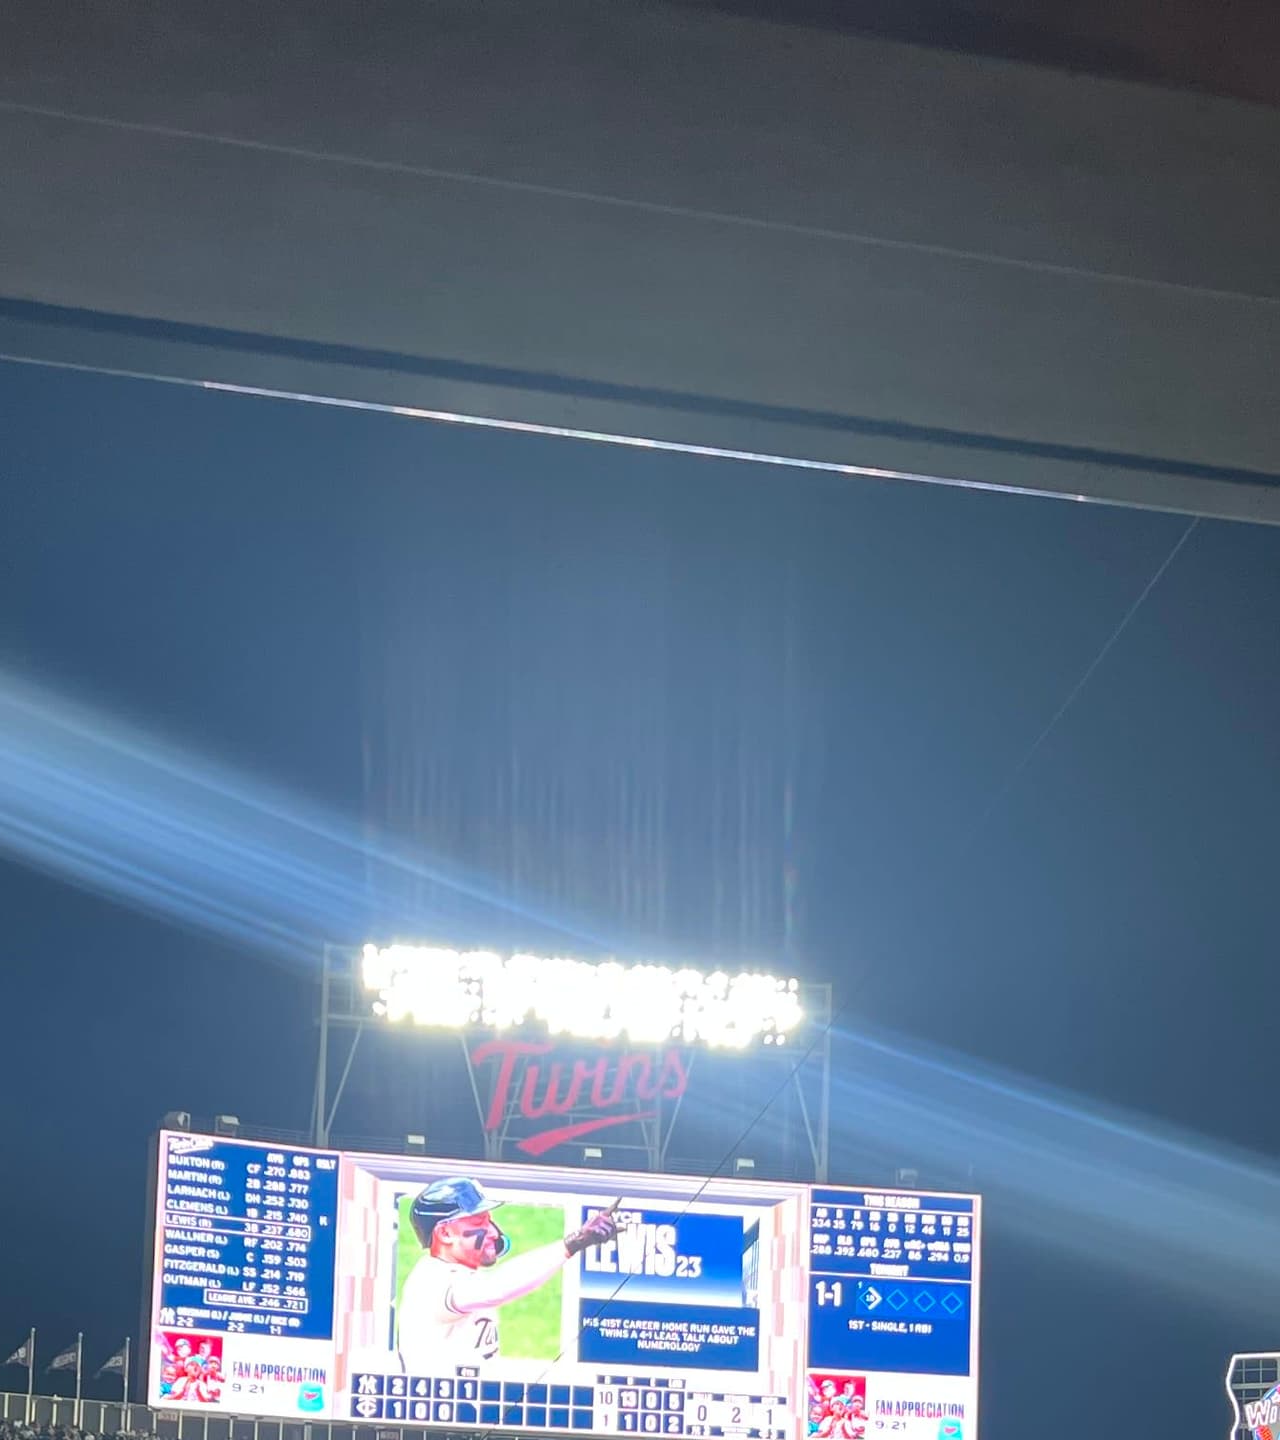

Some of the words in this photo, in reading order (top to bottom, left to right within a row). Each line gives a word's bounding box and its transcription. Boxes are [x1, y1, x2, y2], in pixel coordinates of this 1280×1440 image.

[472, 1038, 687, 1130] Twins
[165, 1214, 197, 1227] LEWIS
[675, 1255, 702, 1278] 23
[816, 1281, 841, 1306] 1-1
[599, 1328, 629, 1339] TWINS
[707, 1333, 739, 1345] ABOUT
[623, 1319, 659, 1331] CAREER
[662, 1321, 688, 1333] HOME
[690, 1323, 710, 1334] RUN
[738, 1326, 756, 1337] THE
[637, 1340, 701, 1352] NUMEROLOGY
[232, 1360, 251, 1379] FAN
[253, 1363, 327, 1384] APPRECIATION
[875, 1400, 893, 1416] FAN
[895, 1401, 965, 1419] APPRECIATION
